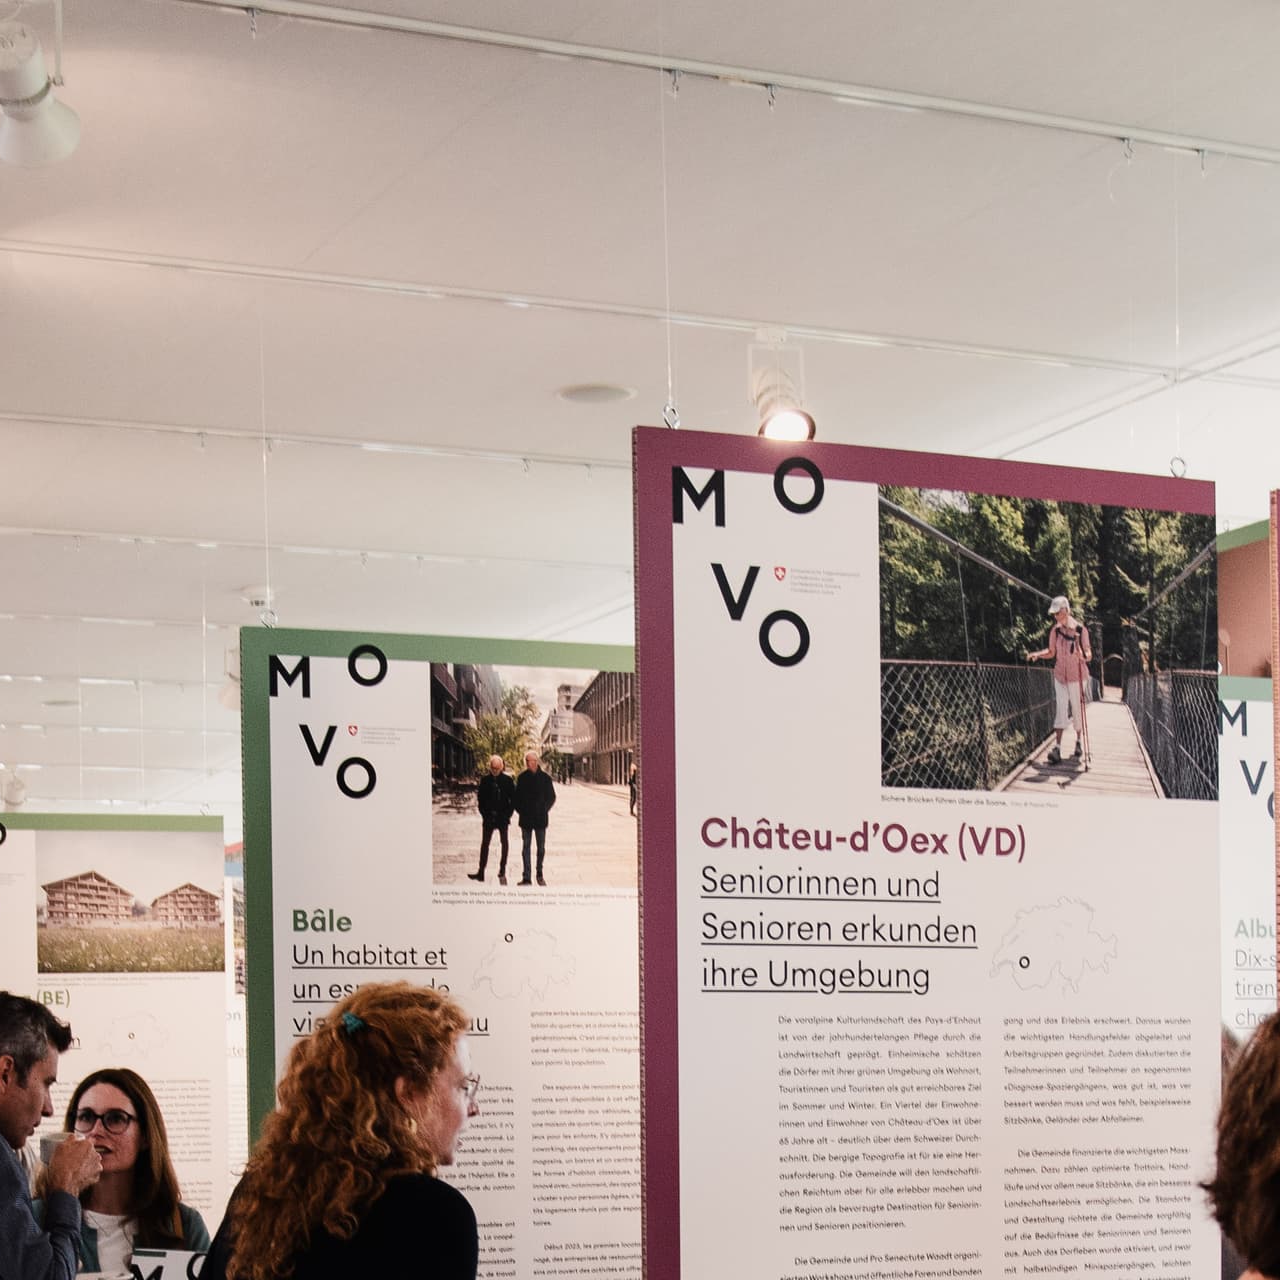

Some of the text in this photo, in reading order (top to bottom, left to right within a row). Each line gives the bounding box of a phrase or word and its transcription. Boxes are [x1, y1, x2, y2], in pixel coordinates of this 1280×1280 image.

[672, 457, 824, 527] M O
[711, 563, 760, 621] V
[759, 610, 810, 667] O
[269, 644, 388, 698] M O
[1218, 700, 1247, 736] M
[299, 724, 337, 766] V
[336, 756, 376, 799] O
[1240, 760, 1267, 795] V
[701, 817, 1025, 863] Châteu-d’Oex (VD)
[702, 865, 939, 897] Seniorinnen und
[292, 909, 352, 932] Bâle
[702, 912, 976, 942] Senioren erkunden
[293, 944, 447, 966] Un habitat et
[293, 984, 320, 999] un
[703, 958, 930, 995] ihre Umgebung
[1236, 978, 1277, 996] tiren
[37, 990, 71, 1008] (BE)
